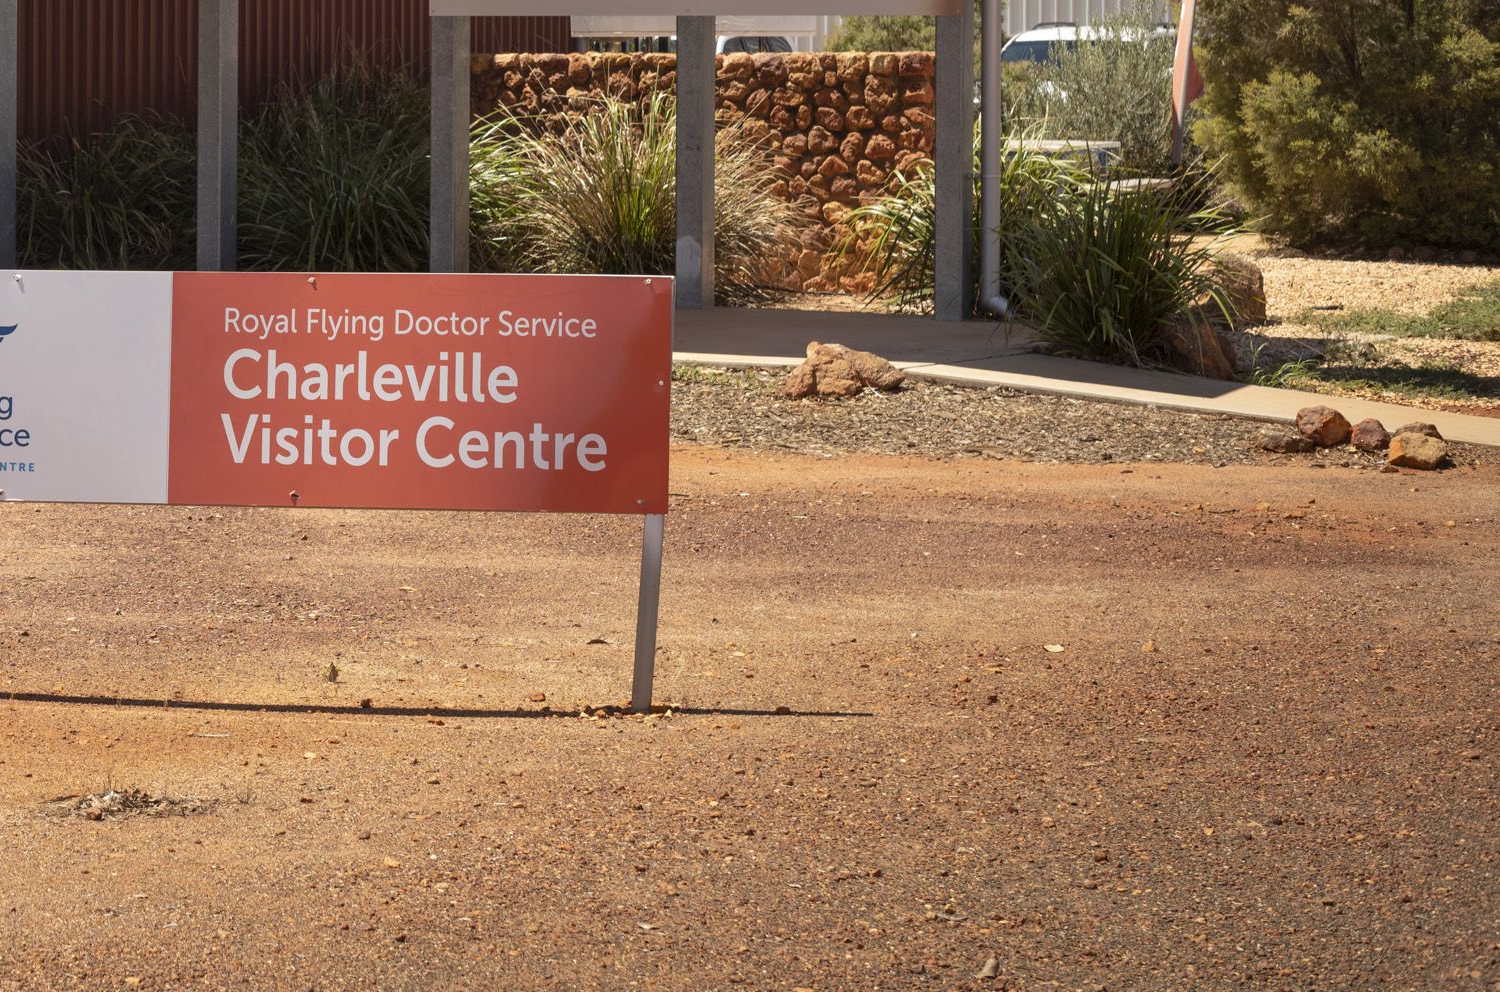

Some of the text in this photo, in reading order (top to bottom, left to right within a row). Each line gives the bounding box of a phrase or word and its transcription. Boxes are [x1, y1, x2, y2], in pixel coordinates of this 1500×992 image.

[225, 308, 596, 341] Royal Flying Doctor Service
[224, 349, 518, 403] Charleville
[221, 414, 606, 471] Visitor Centre
